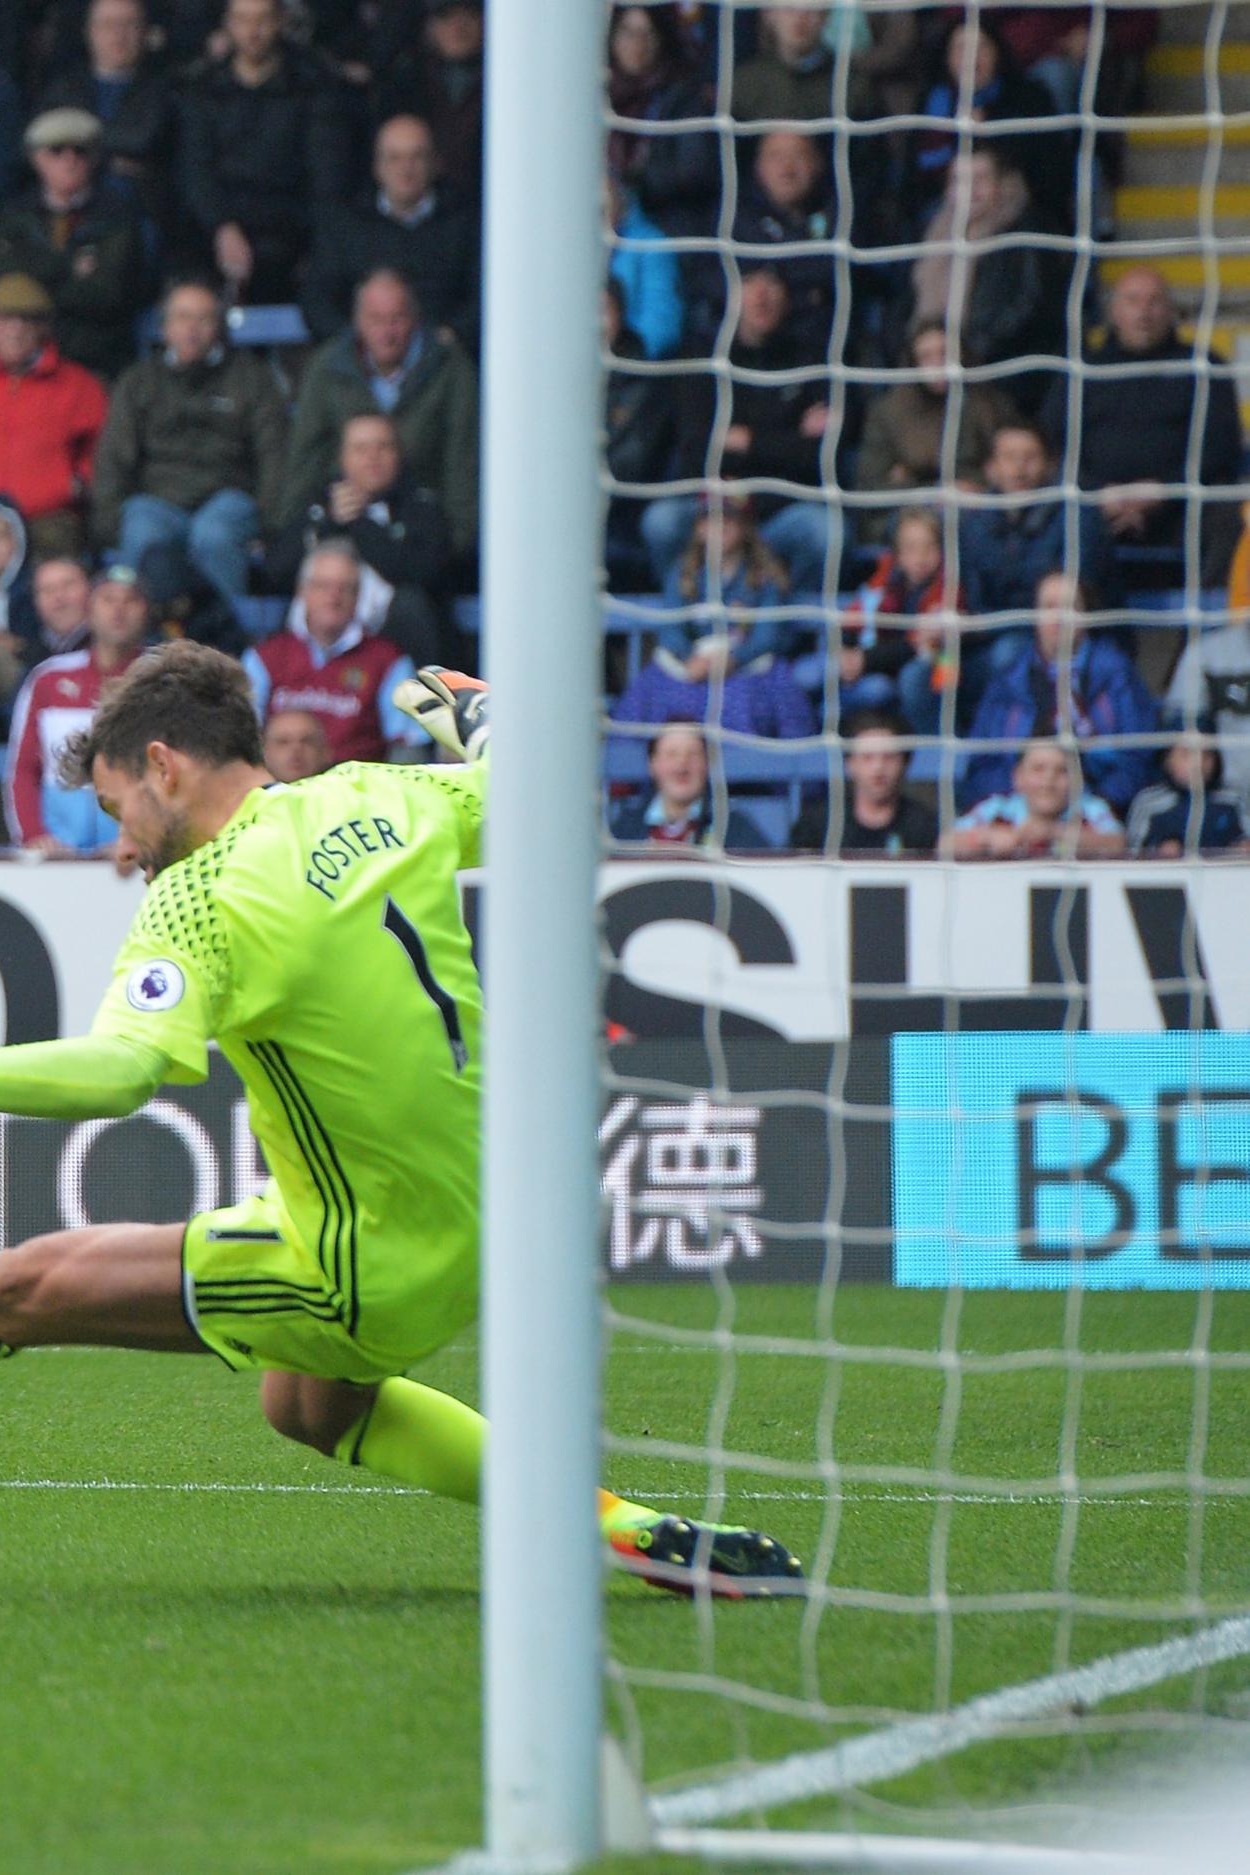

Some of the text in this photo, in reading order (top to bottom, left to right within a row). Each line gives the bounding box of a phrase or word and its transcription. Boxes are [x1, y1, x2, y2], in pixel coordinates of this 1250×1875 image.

[306, 817, 406, 902] FOSTER
[381, 891, 469, 1076] 1
[599, 1092, 764, 1270] 德
